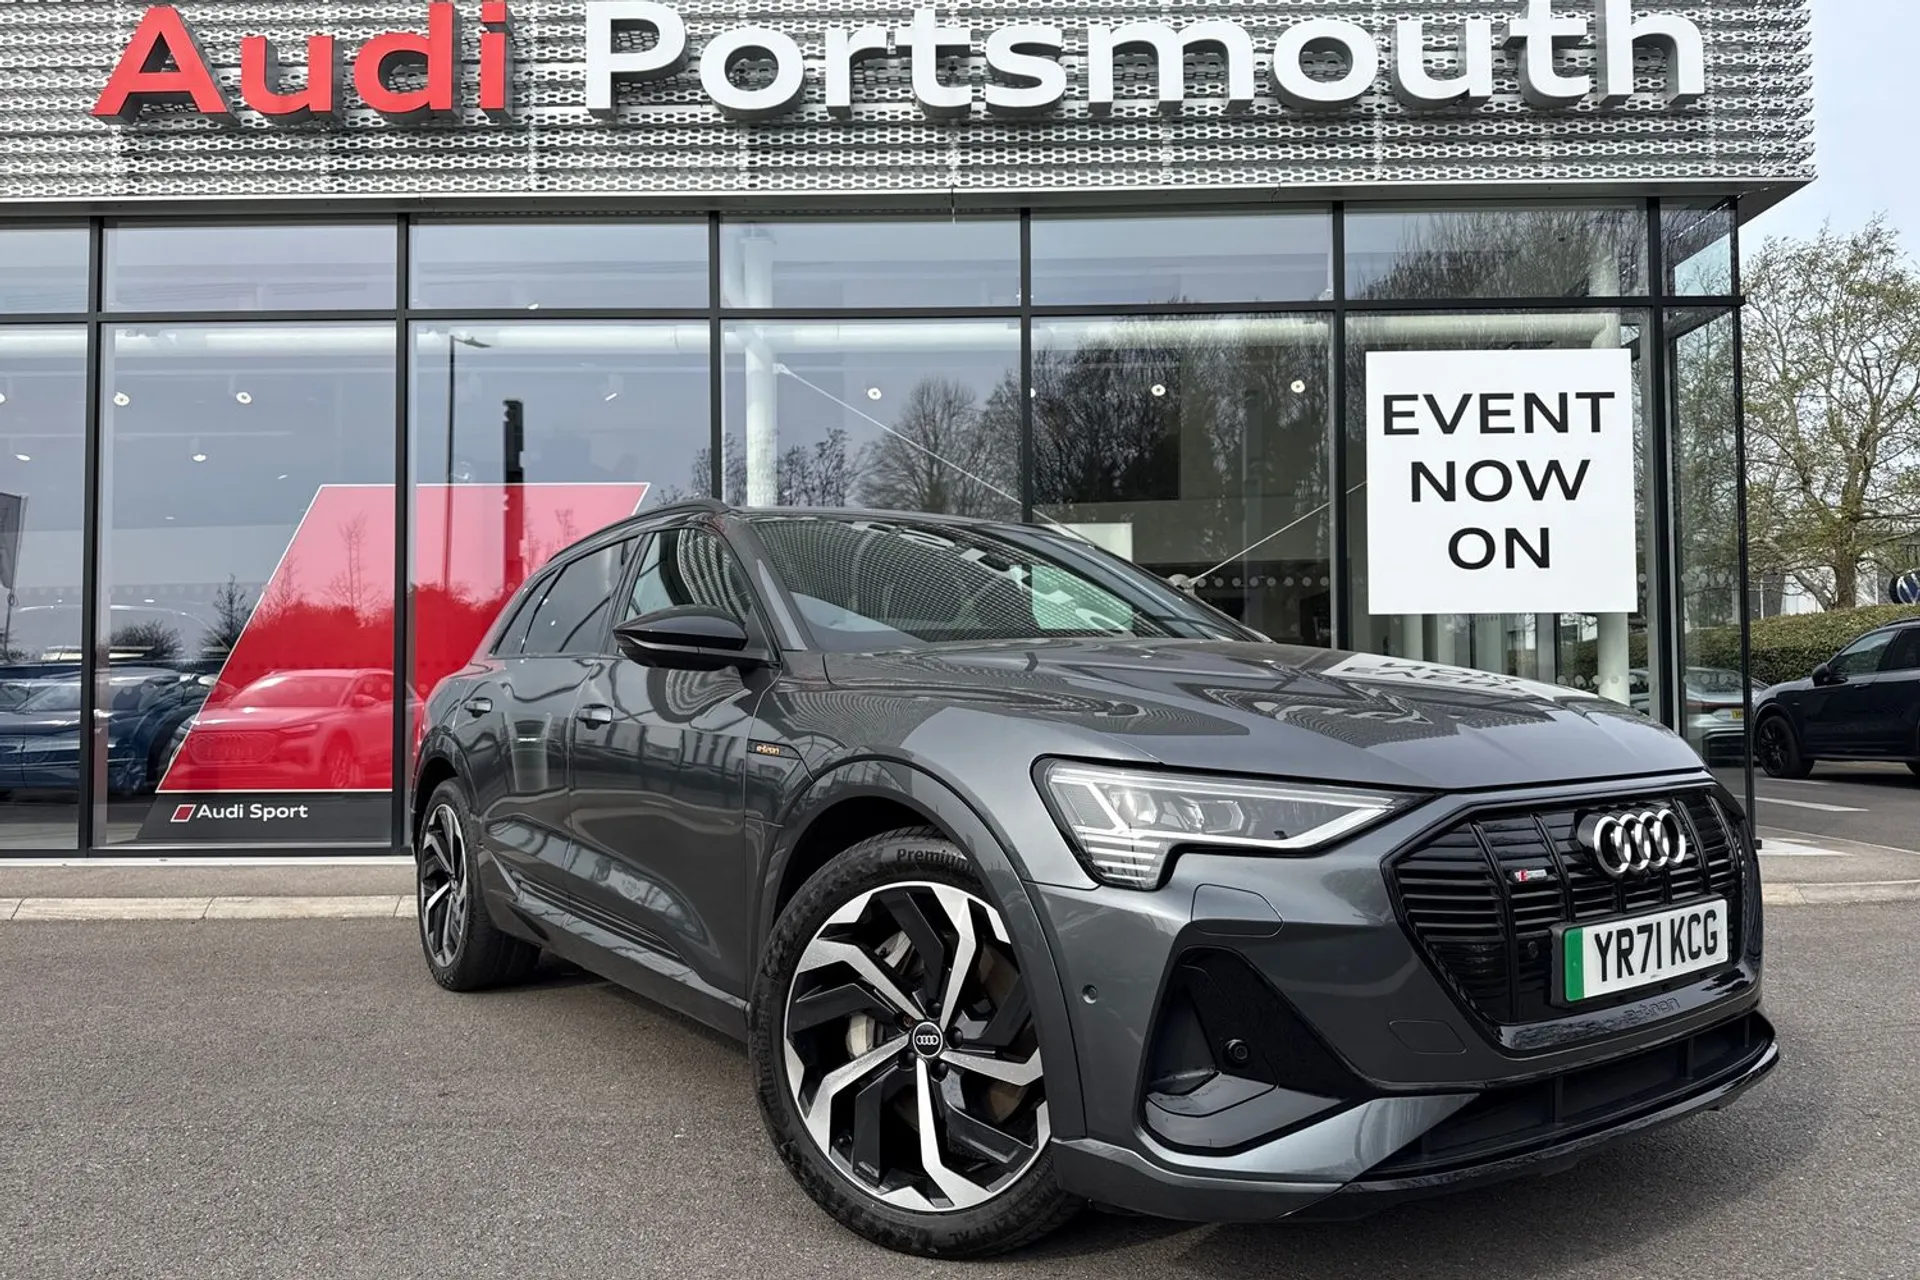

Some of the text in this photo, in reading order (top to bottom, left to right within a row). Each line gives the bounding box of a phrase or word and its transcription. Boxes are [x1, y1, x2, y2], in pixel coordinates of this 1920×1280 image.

[92, 0, 1706, 119] Audi Portsmouth
[1383, 391, 1616, 436] EVENT
[1410, 459, 1591, 503] NOW
[1447, 527, 1551, 570] ON
[196, 803, 309, 822] Audi Sport
[1593, 908, 1718, 983] YR71 KCG
